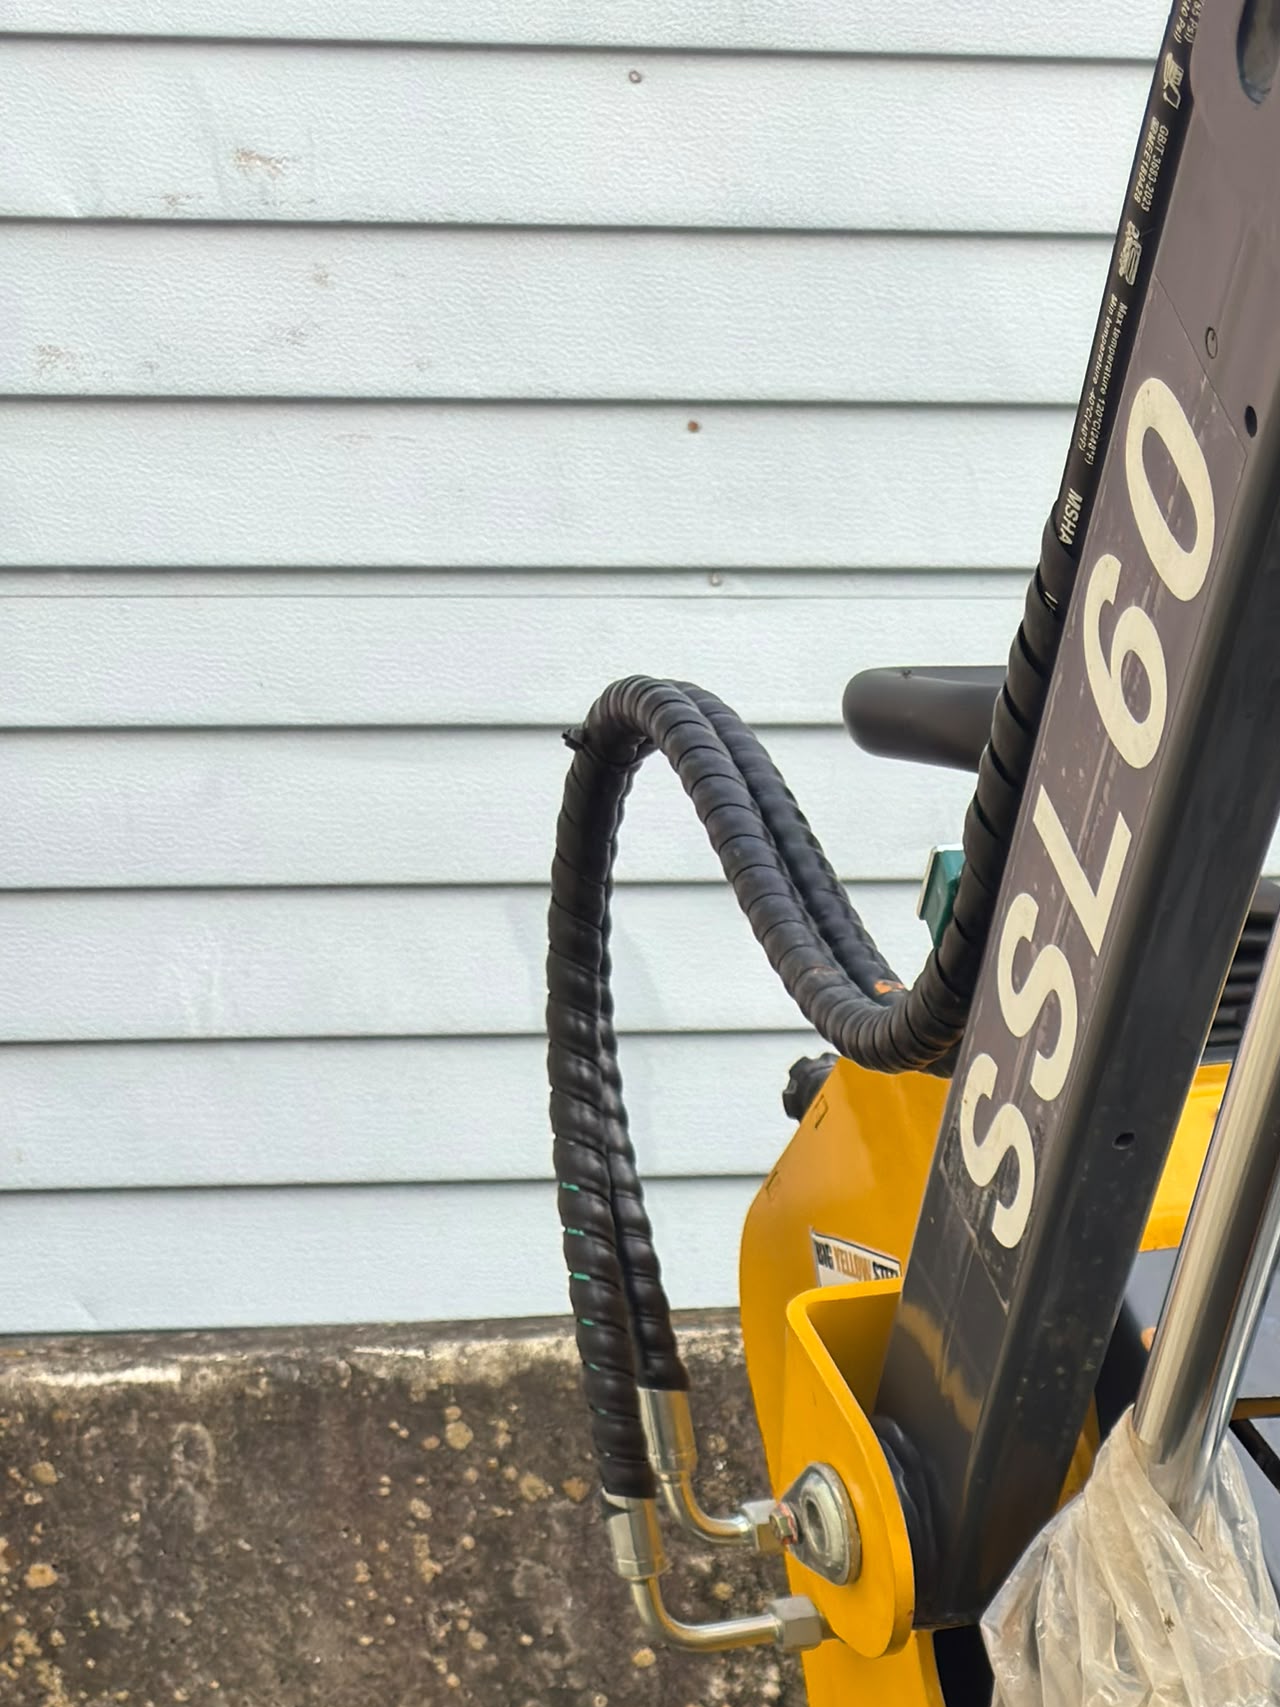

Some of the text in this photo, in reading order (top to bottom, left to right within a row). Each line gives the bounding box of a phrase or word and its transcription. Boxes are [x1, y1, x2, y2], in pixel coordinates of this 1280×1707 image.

[1141, 125, 1169, 212] GB/T 3683-2023
[1107, 293, 1118, 315] Min
[1115, 302, 1128, 326] Max
[1093, 316, 1113, 385] temperature
[1100, 327, 1122, 395] temperature
[1058, 488, 1083, 545] MSHA
[960, 377, 1215, 1248] SSL60
[814, 1240, 834, 1270] BIG
[833, 1245, 872, 1281] YELLOW
